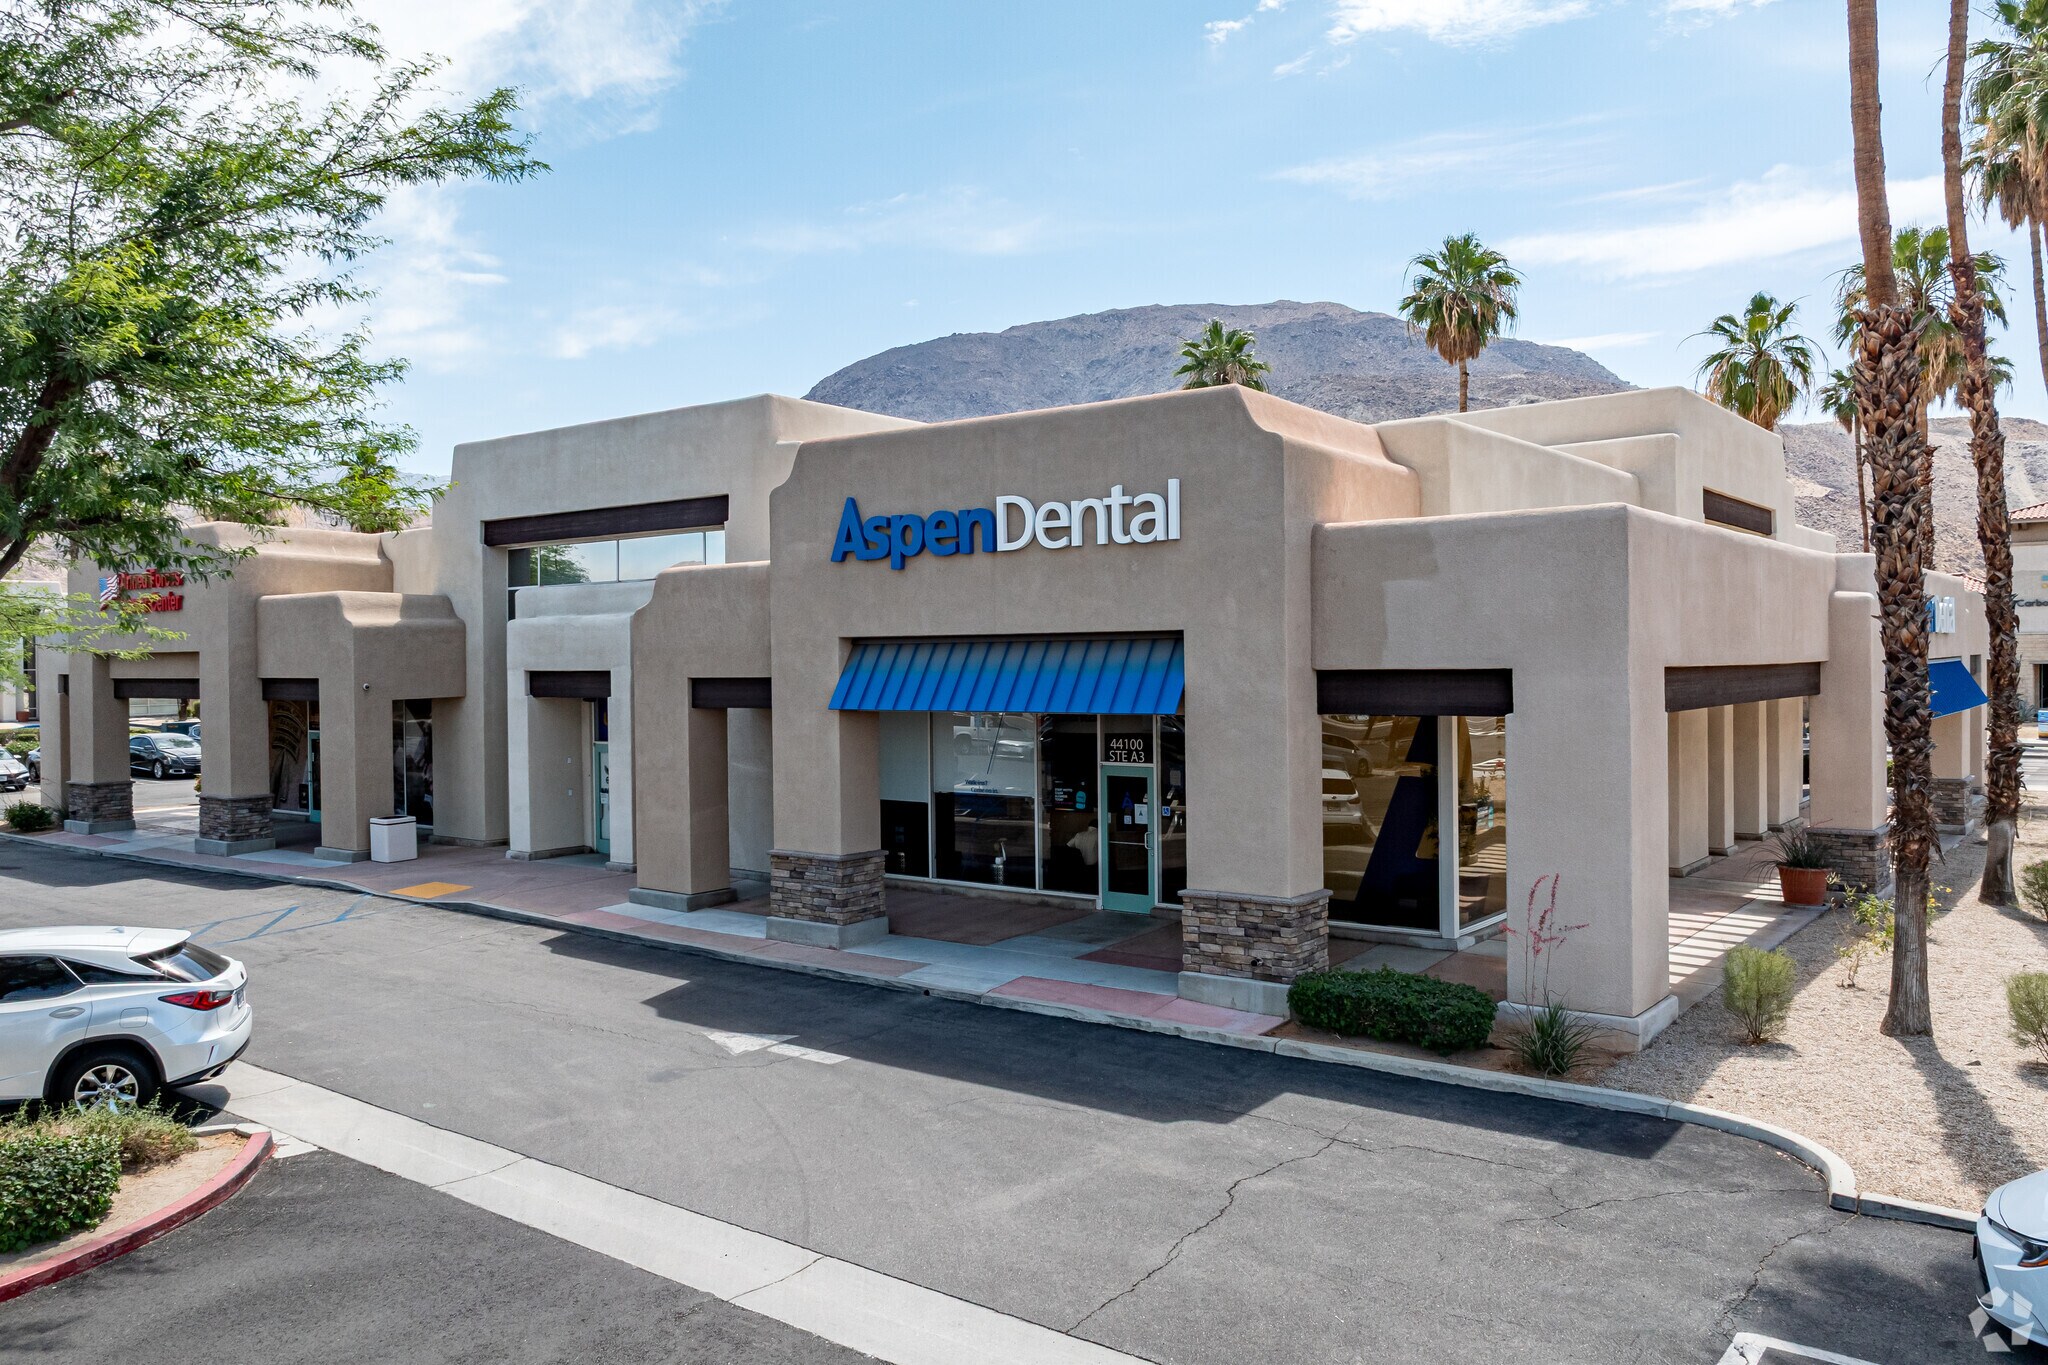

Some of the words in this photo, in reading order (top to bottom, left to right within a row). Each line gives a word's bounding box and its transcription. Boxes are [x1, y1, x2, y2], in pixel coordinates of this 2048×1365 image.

[1110, 738, 1144, 750] 44100
[1109, 750, 1128, 762] STE
[1130, 751, 1145, 763] A3
